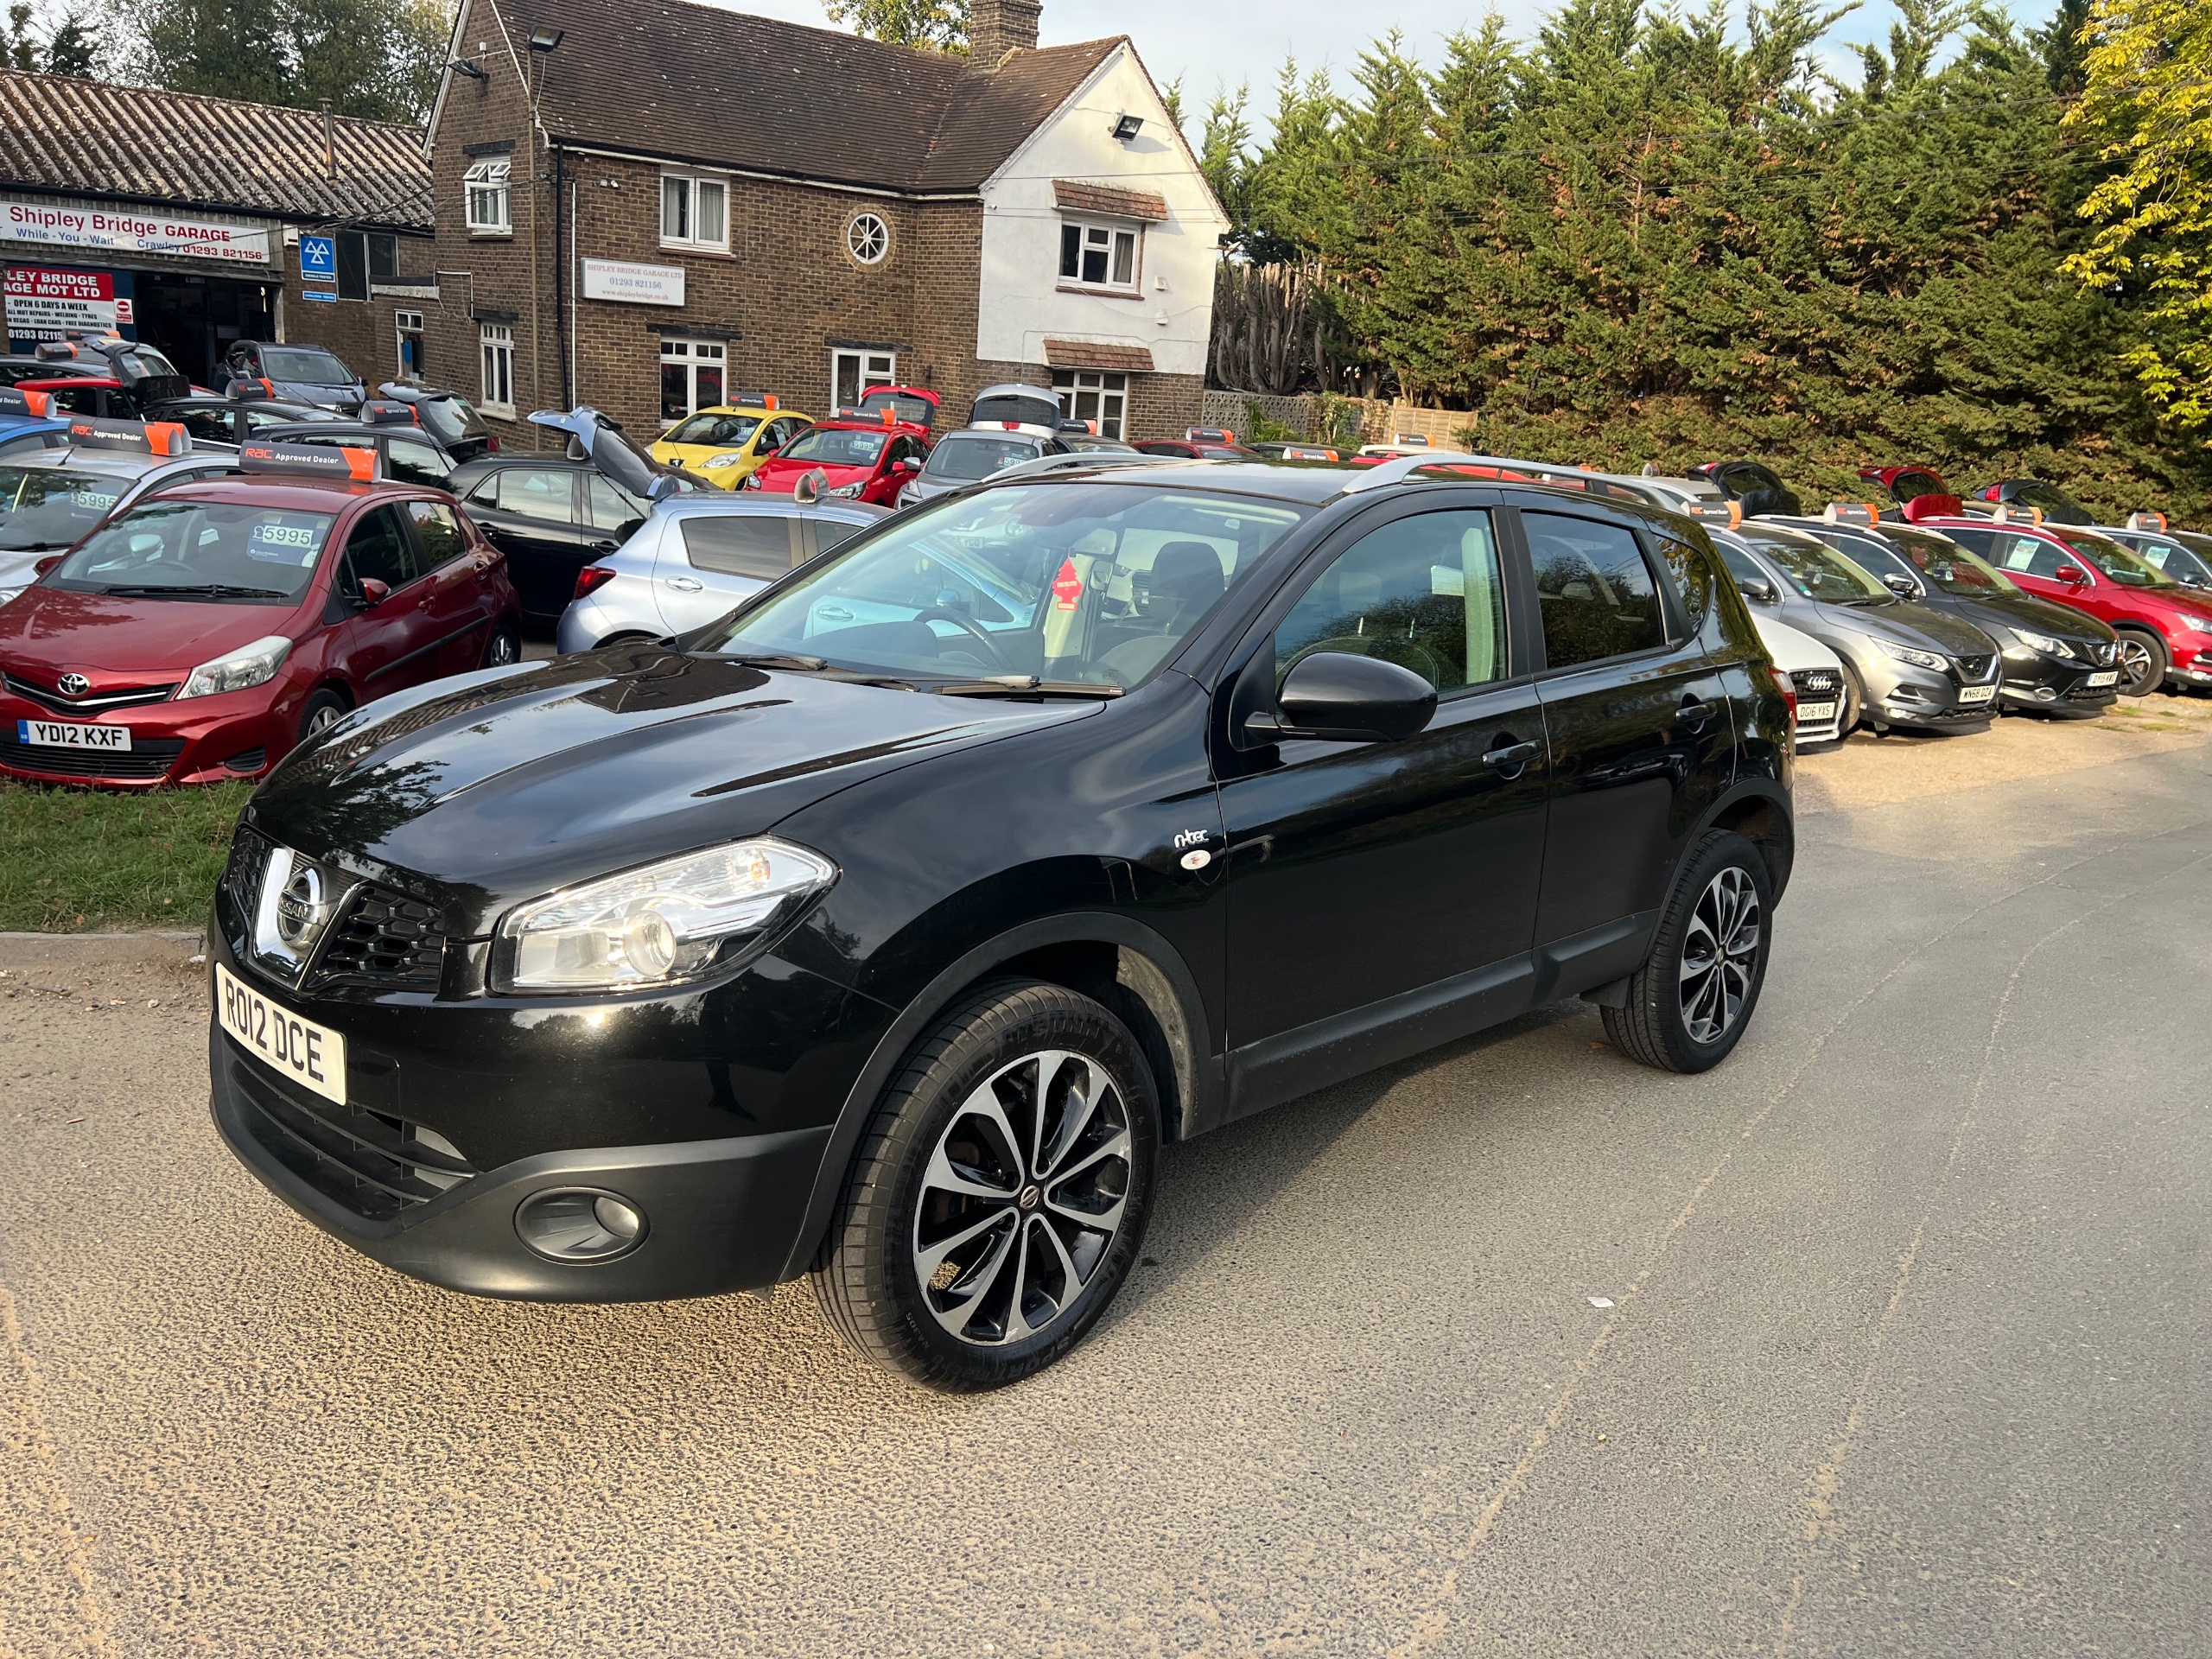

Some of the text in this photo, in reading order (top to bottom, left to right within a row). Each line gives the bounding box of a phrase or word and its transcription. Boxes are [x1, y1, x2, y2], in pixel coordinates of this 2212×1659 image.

[10, 206, 85, 232] Shipley
[92, 214, 156, 237] Bridge
[165, 225, 231, 242] GARAGE
[16, 228, 262, 259] While You Wait Crawley 01293 821156
[587, 264, 615, 273] SHIPLEY
[617, 266, 641, 275] BRIDGE
[41, 272, 97, 286] BRIDGE
[609, 277, 662, 289] 01293 821156
[36, 283, 68, 296] MOT
[74, 286, 100, 297] LTD
[14, 299, 33, 308] OPEN
[41, 301, 60, 309] DAYS
[67, 302, 88, 311] WEEK
[8, 328, 36, 340] 01293
[93, 430, 121, 440] Approved
[122, 433, 143, 442] Dealer
[245, 448, 340, 464] RAC Approved Dealer
[35, 723, 79, 744] YD12
[85, 728, 123, 747] KXF
[226, 976, 324, 1084] RO12 DCE
